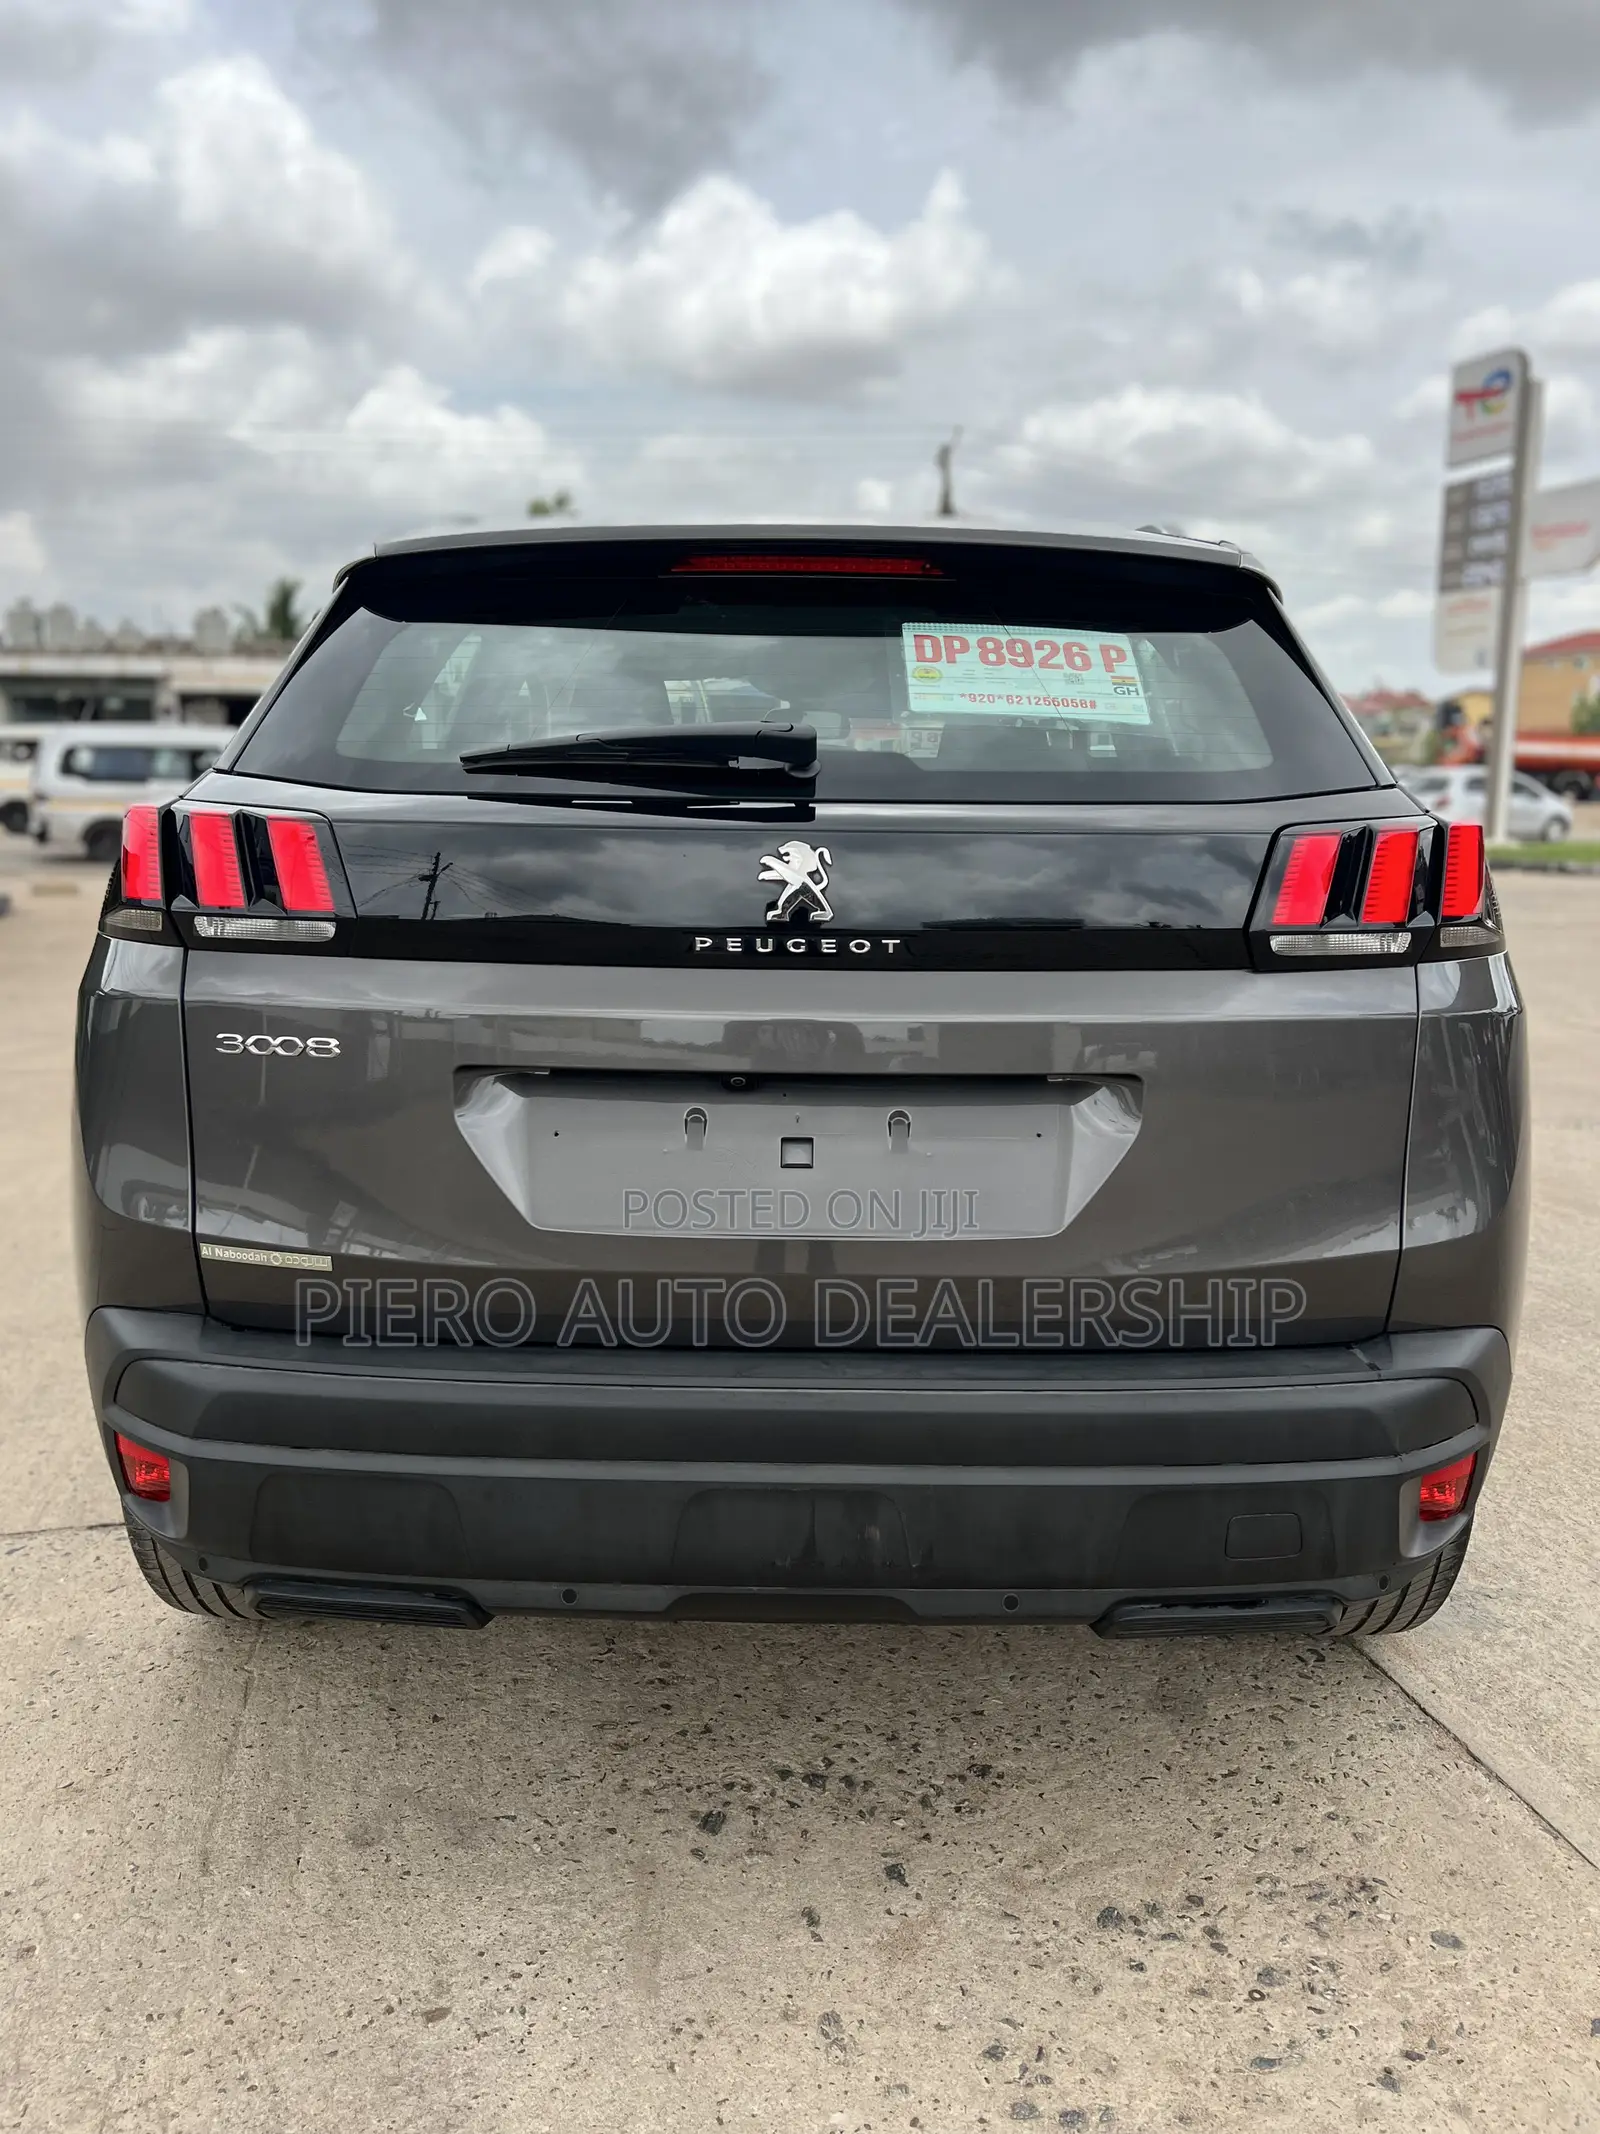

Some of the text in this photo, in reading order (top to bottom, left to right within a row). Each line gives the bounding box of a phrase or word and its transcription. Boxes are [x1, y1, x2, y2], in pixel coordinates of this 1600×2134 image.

[913, 634, 1128, 673] DP 8926 P
[1113, 686, 1140, 696] GH
[694, 936, 901, 954] PEUGEOT
[215, 1033, 341, 1058] 3008
[201, 1246, 268, 1263] Al Naboodah
